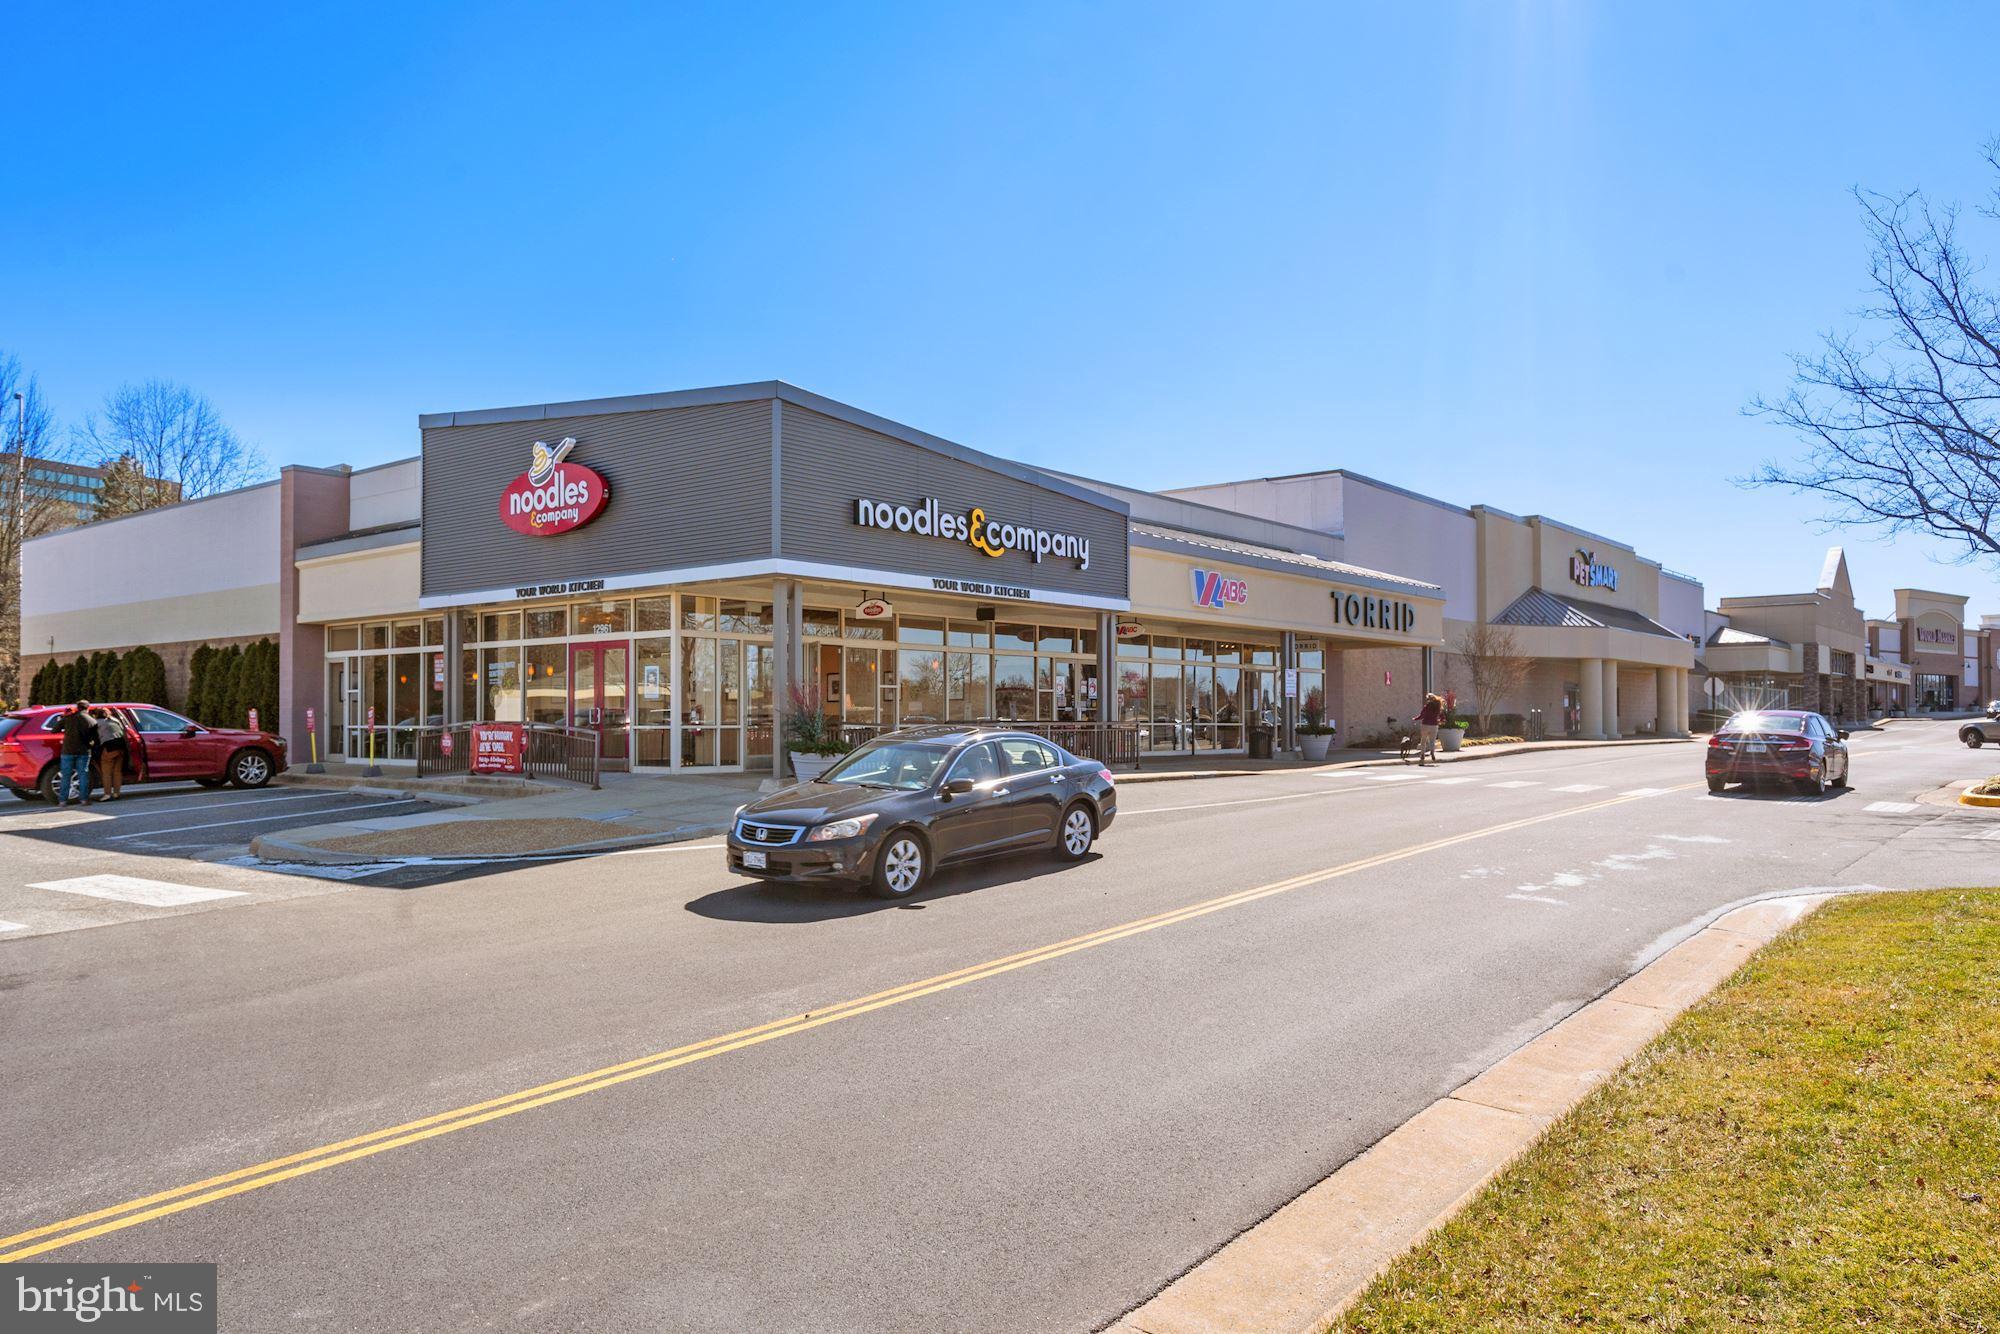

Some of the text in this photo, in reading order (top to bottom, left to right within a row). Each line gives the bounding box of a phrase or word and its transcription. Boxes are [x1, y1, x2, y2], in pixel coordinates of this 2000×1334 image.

[510, 470, 589, 515] noodles
[516, 579, 605, 598] YOUR WORLD KITCHEN
[932, 578, 1031, 599] YOUR WORLD KITCHEN
[1218, 579, 1248, 604] ABC
[1330, 591, 1417, 632] TORRID
